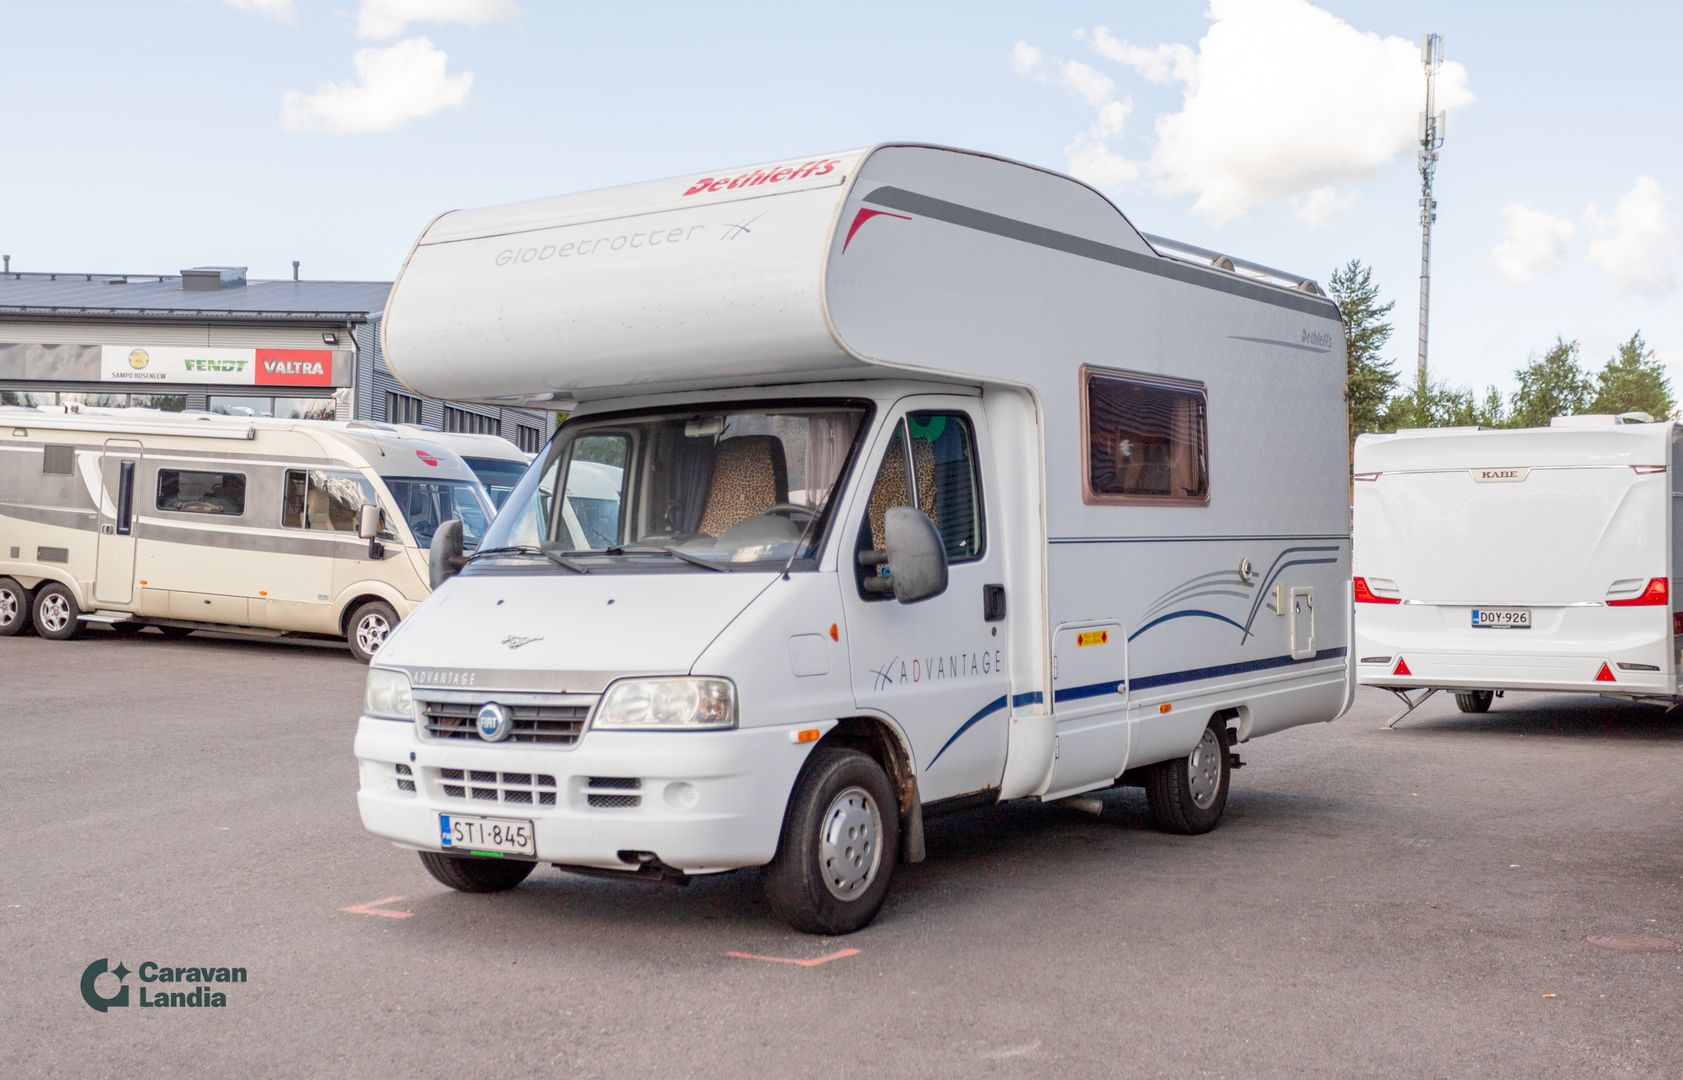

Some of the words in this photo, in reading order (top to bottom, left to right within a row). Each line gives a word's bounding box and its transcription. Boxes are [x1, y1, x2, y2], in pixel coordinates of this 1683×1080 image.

[682, 158, 842, 197] Dethleffs
[184, 358, 249, 373] FENDT
[263, 358, 324, 375] VALTRA
[112, 371, 134, 379] SAMPO
[134, 372, 167, 380] ROSENLEW
[1481, 471, 1518, 479] KABE
[1480, 612, 1527, 623] DOY-926
[900, 650, 1000, 685] ADVANTAGE
[413, 671, 477, 686] ADVANTAGE
[480, 716, 498, 729] FIAT
[454, 821, 528, 848] STI-845
